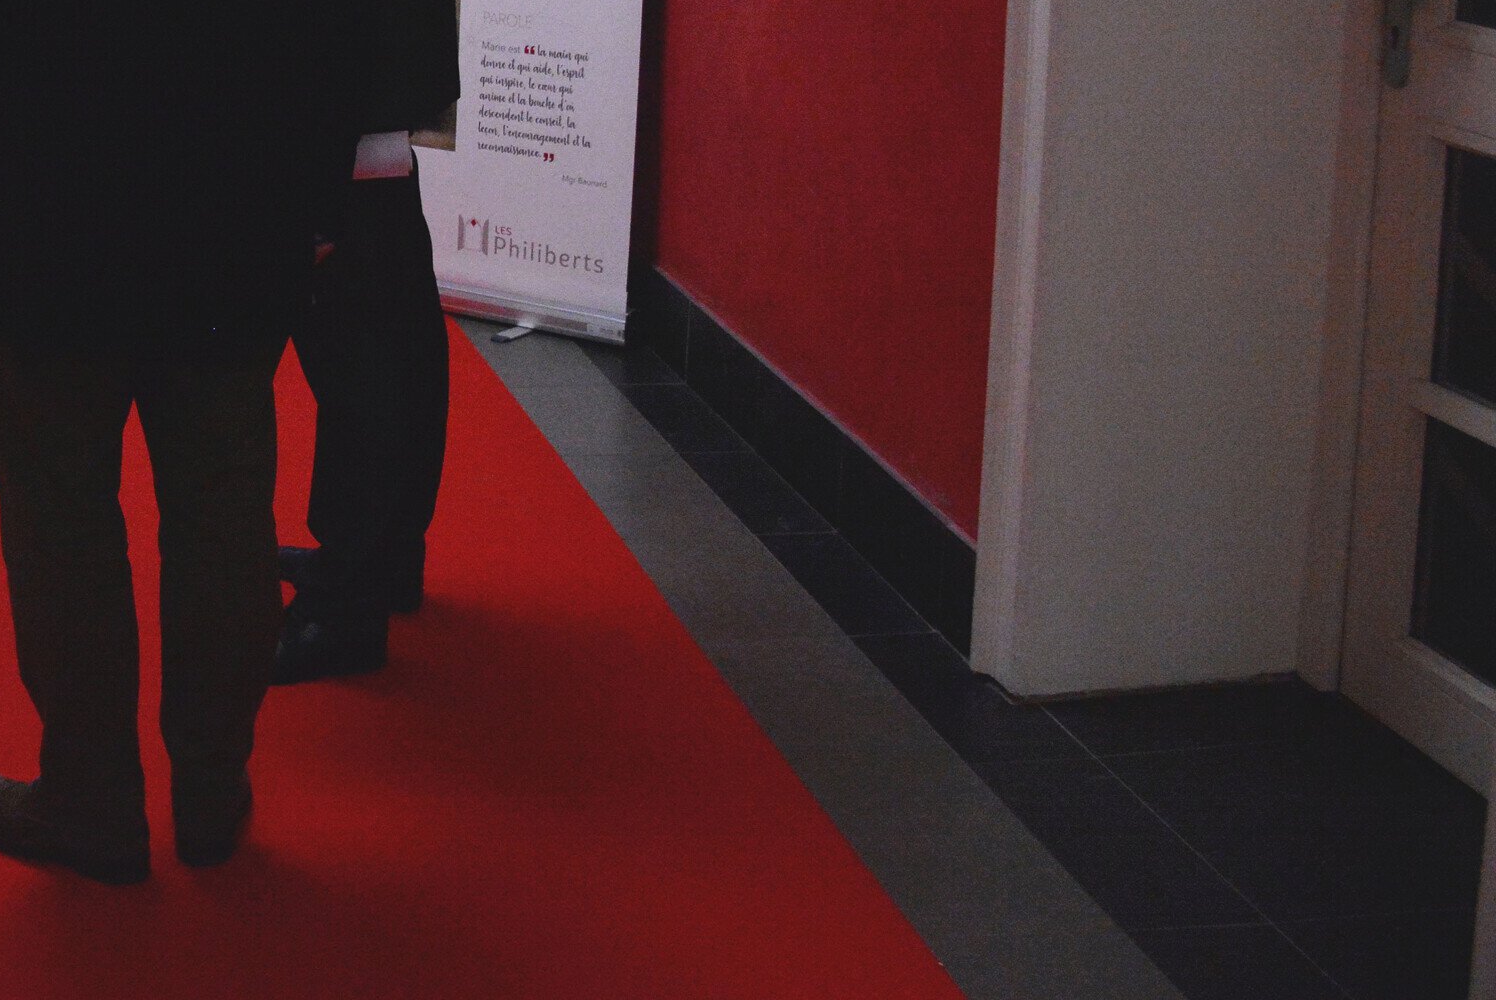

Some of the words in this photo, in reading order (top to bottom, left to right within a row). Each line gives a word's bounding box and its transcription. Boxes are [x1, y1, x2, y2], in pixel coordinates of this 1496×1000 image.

[574, 52, 588, 65] qui
[517, 62, 530, 75] qui
[479, 75, 493, 87] qui
[559, 85, 573, 97] qui
[495, 226, 512, 236] LES
[494, 236, 604, 274] Philiberts
